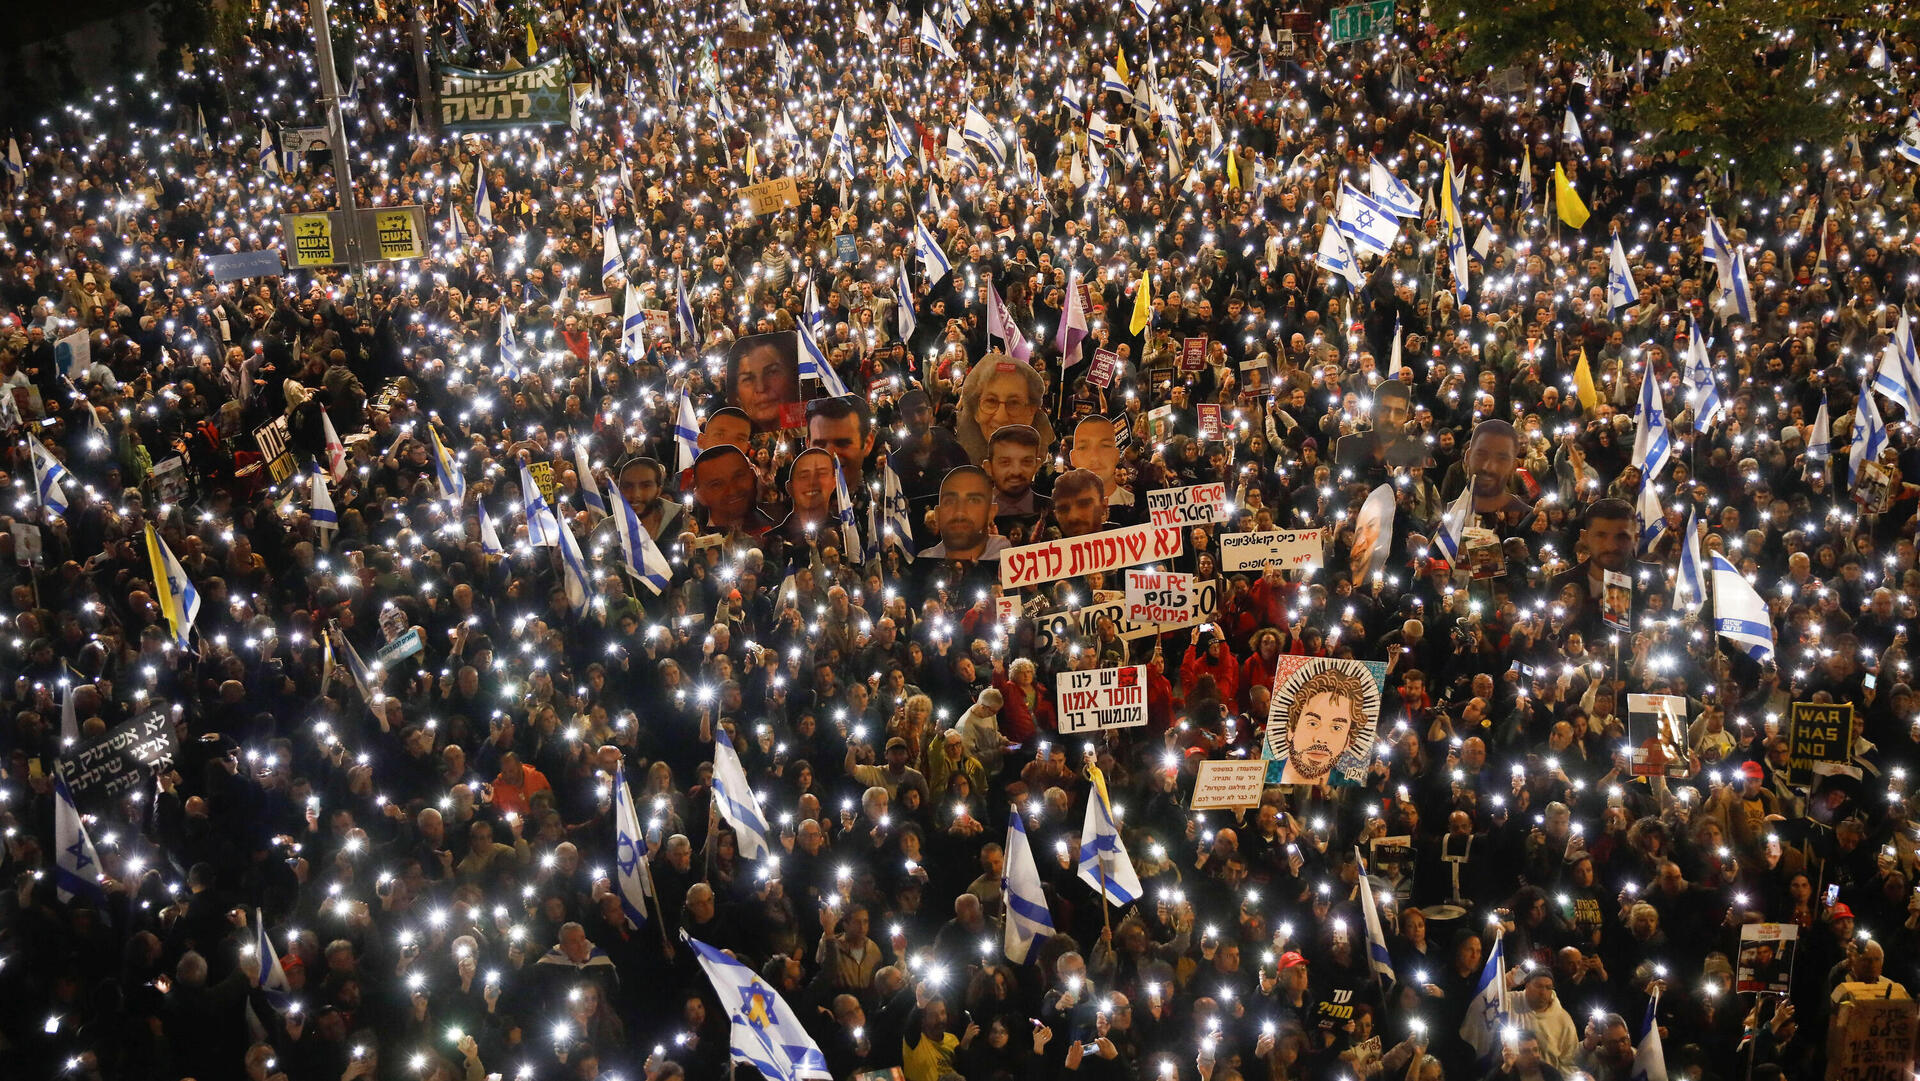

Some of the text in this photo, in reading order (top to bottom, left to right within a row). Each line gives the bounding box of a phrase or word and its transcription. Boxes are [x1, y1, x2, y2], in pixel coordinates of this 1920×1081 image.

[441, 91, 531, 125] לנשק
[740, 180, 790, 199] עם ישראל
[298, 237, 329, 248] אשם
[381, 230, 412, 241] אשם
[298, 249, 331, 259] במחדל
[382, 243, 413, 253] במחדל
[1148, 485, 1225, 510] ישראל לא תהיה
[1276, 533, 1296, 544] כיס
[1299, 532, 1318, 541] דמי
[1069, 530, 1148, 576] שוכחות
[1293, 553, 1312, 564] דמי
[1008, 542, 1063, 584] לרגע
[1129, 573, 1186, 591] גם מחר
[1144, 591, 1188, 606] כולם
[1130, 604, 1189, 622] בירושלים
[1071, 671, 1117, 688] יש לנו
[1062, 686, 1142, 713] חוסר אמון
[144, 711, 165, 736] לא
[1066, 706, 1142, 731] מתמשך בך
[1798, 709, 1841, 723] WAR
[1798, 726, 1838, 741] HAS
[1797, 743, 1825, 756] NO
[69, 733, 170, 794] ארצי שינתה
[105, 752, 174, 796] את פניה
[1345, 767, 1362, 779] אלון
[1333, 989, 1353, 1004] עד
[1317, 1001, 1354, 1019] מתי?
